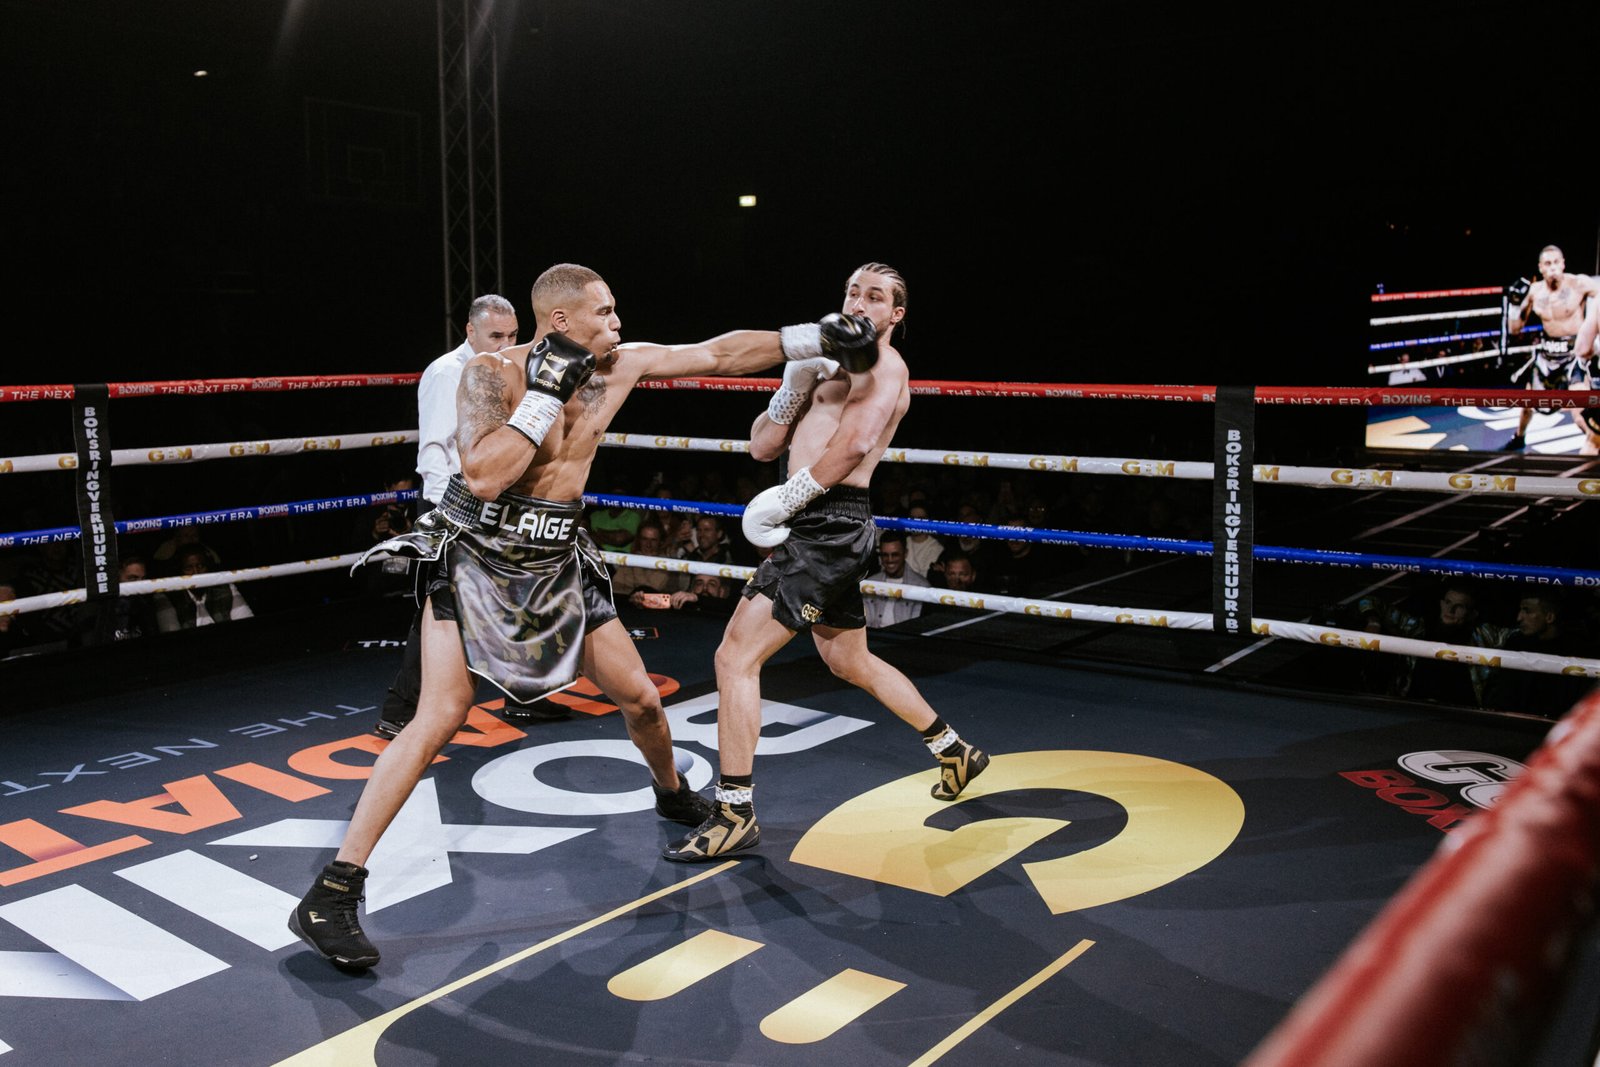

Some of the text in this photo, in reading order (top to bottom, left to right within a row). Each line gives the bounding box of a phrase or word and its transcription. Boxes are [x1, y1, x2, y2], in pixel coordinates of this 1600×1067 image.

[118, 385, 156, 396] BOXING
[161, 386, 185, 395] THE
[189, 383, 219, 394] NEXT
[223, 383, 245, 393] ERA
[252, 380, 283, 391] BOXING
[287, 382, 308, 390] THE
[310, 381, 339, 389] NEXT
[648, 381, 670, 390] ERA
[12, 391, 40, 401] THE
[44, 389, 76, 400] NEX
[1382, 394, 1432, 405] BOXING
[1442, 397, 1476, 407] THE
[1483, 398, 1530, 407] NEXT
[1538, 398, 1577, 407] ERA
[602, 499, 620, 507] THE
[127, 519, 162, 531] BOXING
[168, 517, 193, 528] THE
[196, 513, 227, 525] NEXT
[229, 510, 253, 521] ERA
[258, 504, 289, 515] BOXING
[294, 503, 314, 514] THE
[318, 499, 344, 511] NEXT
[346, 497, 367, 508] ERA
[371, 491, 398, 502] BOXING
[479, 501, 575, 541] ELAIGE
[22, 536, 48, 546] THE
[54, 531, 82, 542] NEX
[0, 704, 378, 797] THE NEXT
